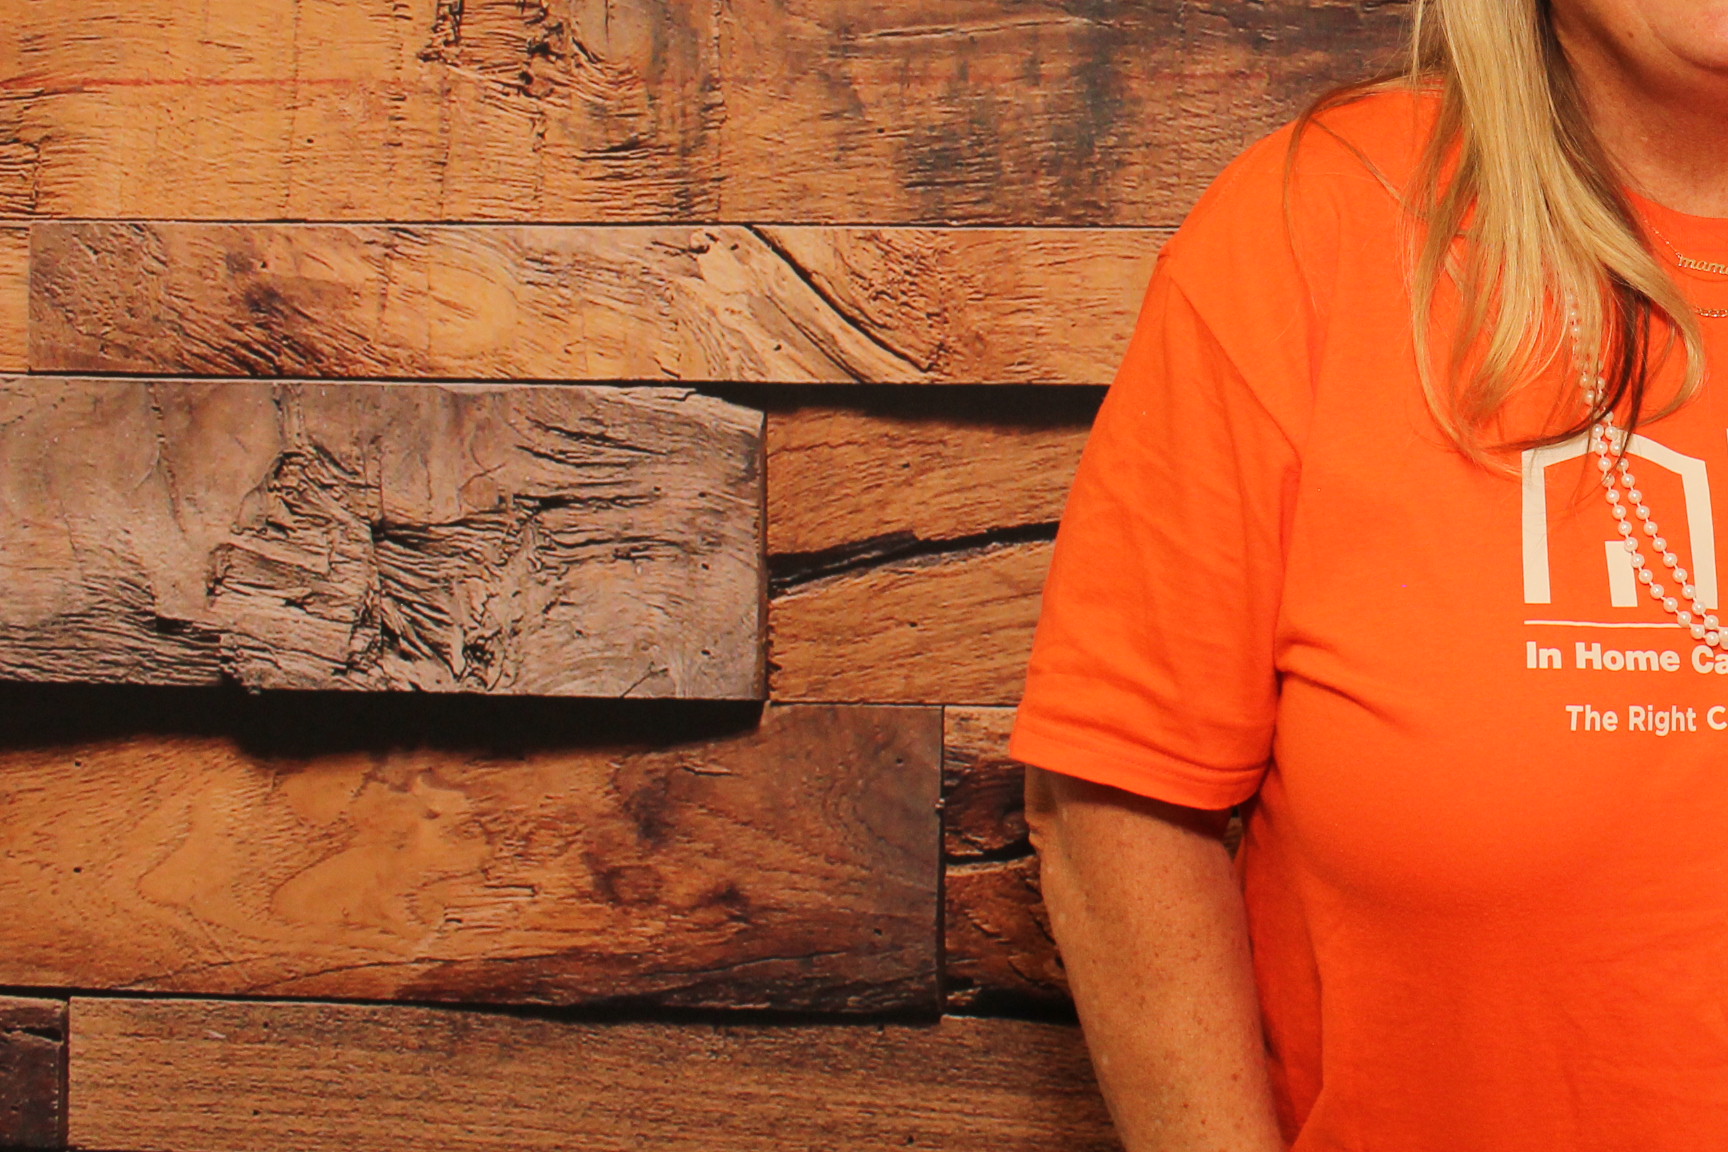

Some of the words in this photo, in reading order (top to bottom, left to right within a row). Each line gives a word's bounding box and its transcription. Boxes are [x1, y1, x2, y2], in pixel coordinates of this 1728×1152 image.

[1526, 641, 1562, 669] In
[1575, 642, 1680, 672] Home
[1565, 704, 1619, 732] The
[1628, 704, 1697, 737] Right
